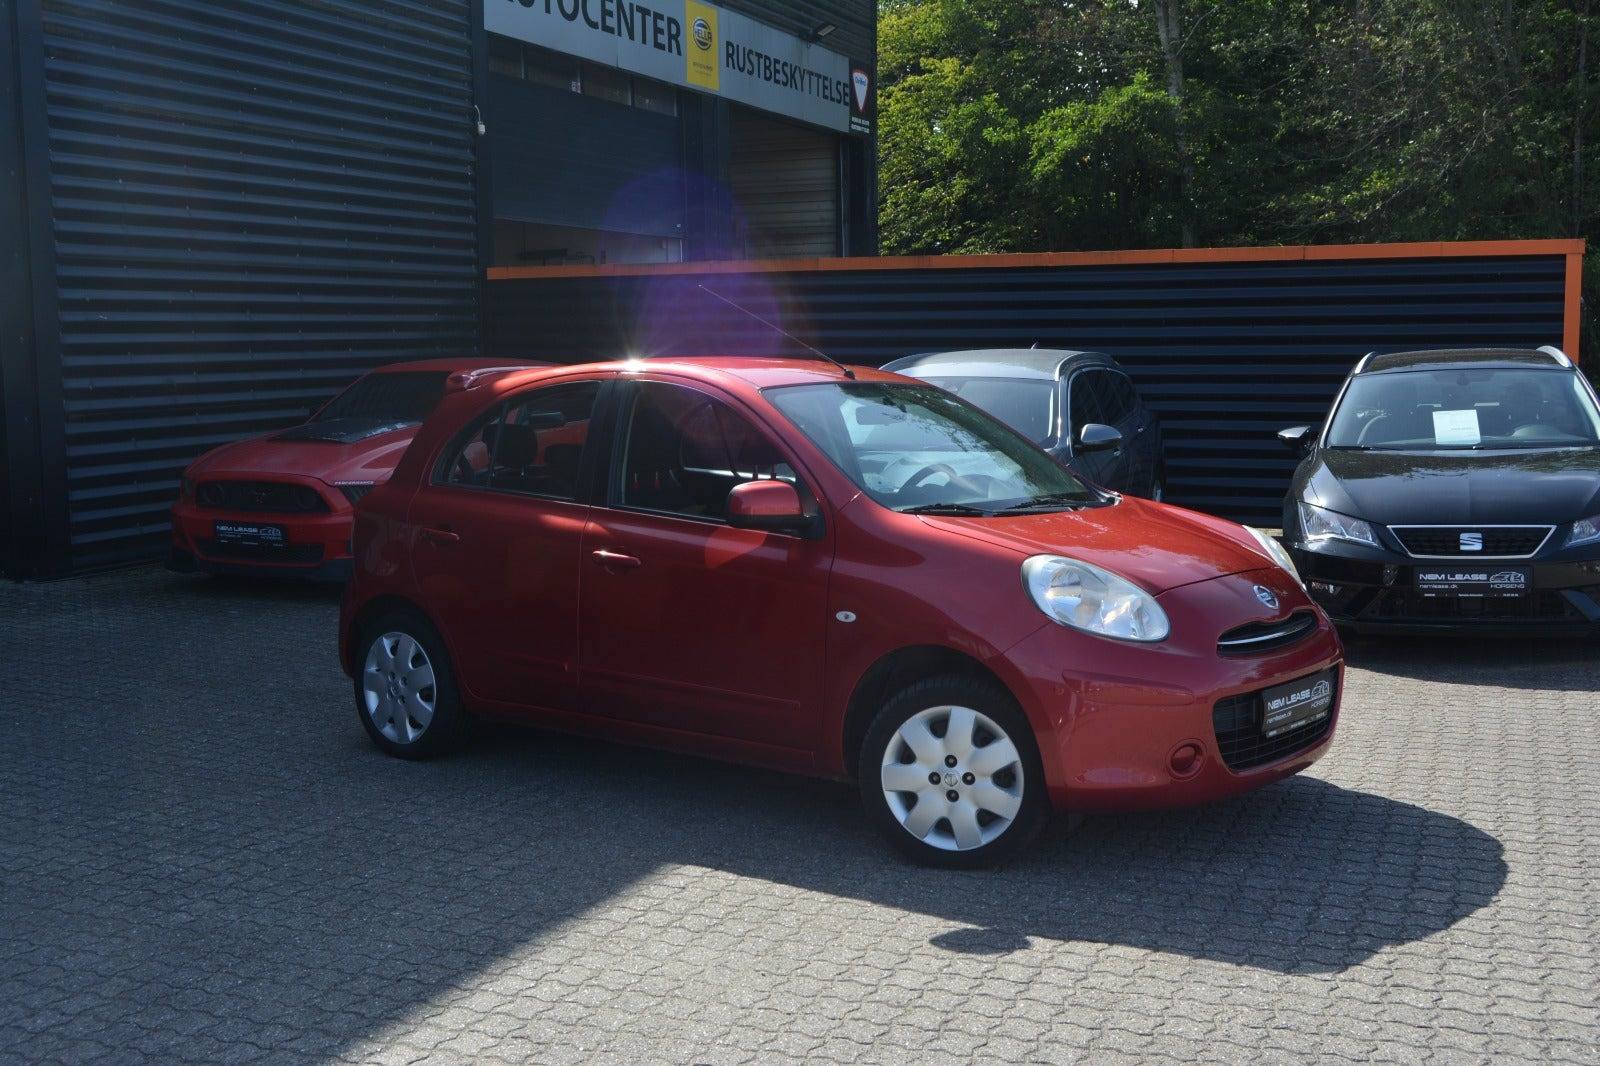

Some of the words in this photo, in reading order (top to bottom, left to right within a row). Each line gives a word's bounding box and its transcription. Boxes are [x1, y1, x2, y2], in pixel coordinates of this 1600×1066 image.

[507, 0, 682, 56] OCENTER
[725, 40, 849, 107] RUSTBESKYTTELSE
[1267, 697, 1285, 711] NEM
[1285, 688, 1311, 705] LEASE
